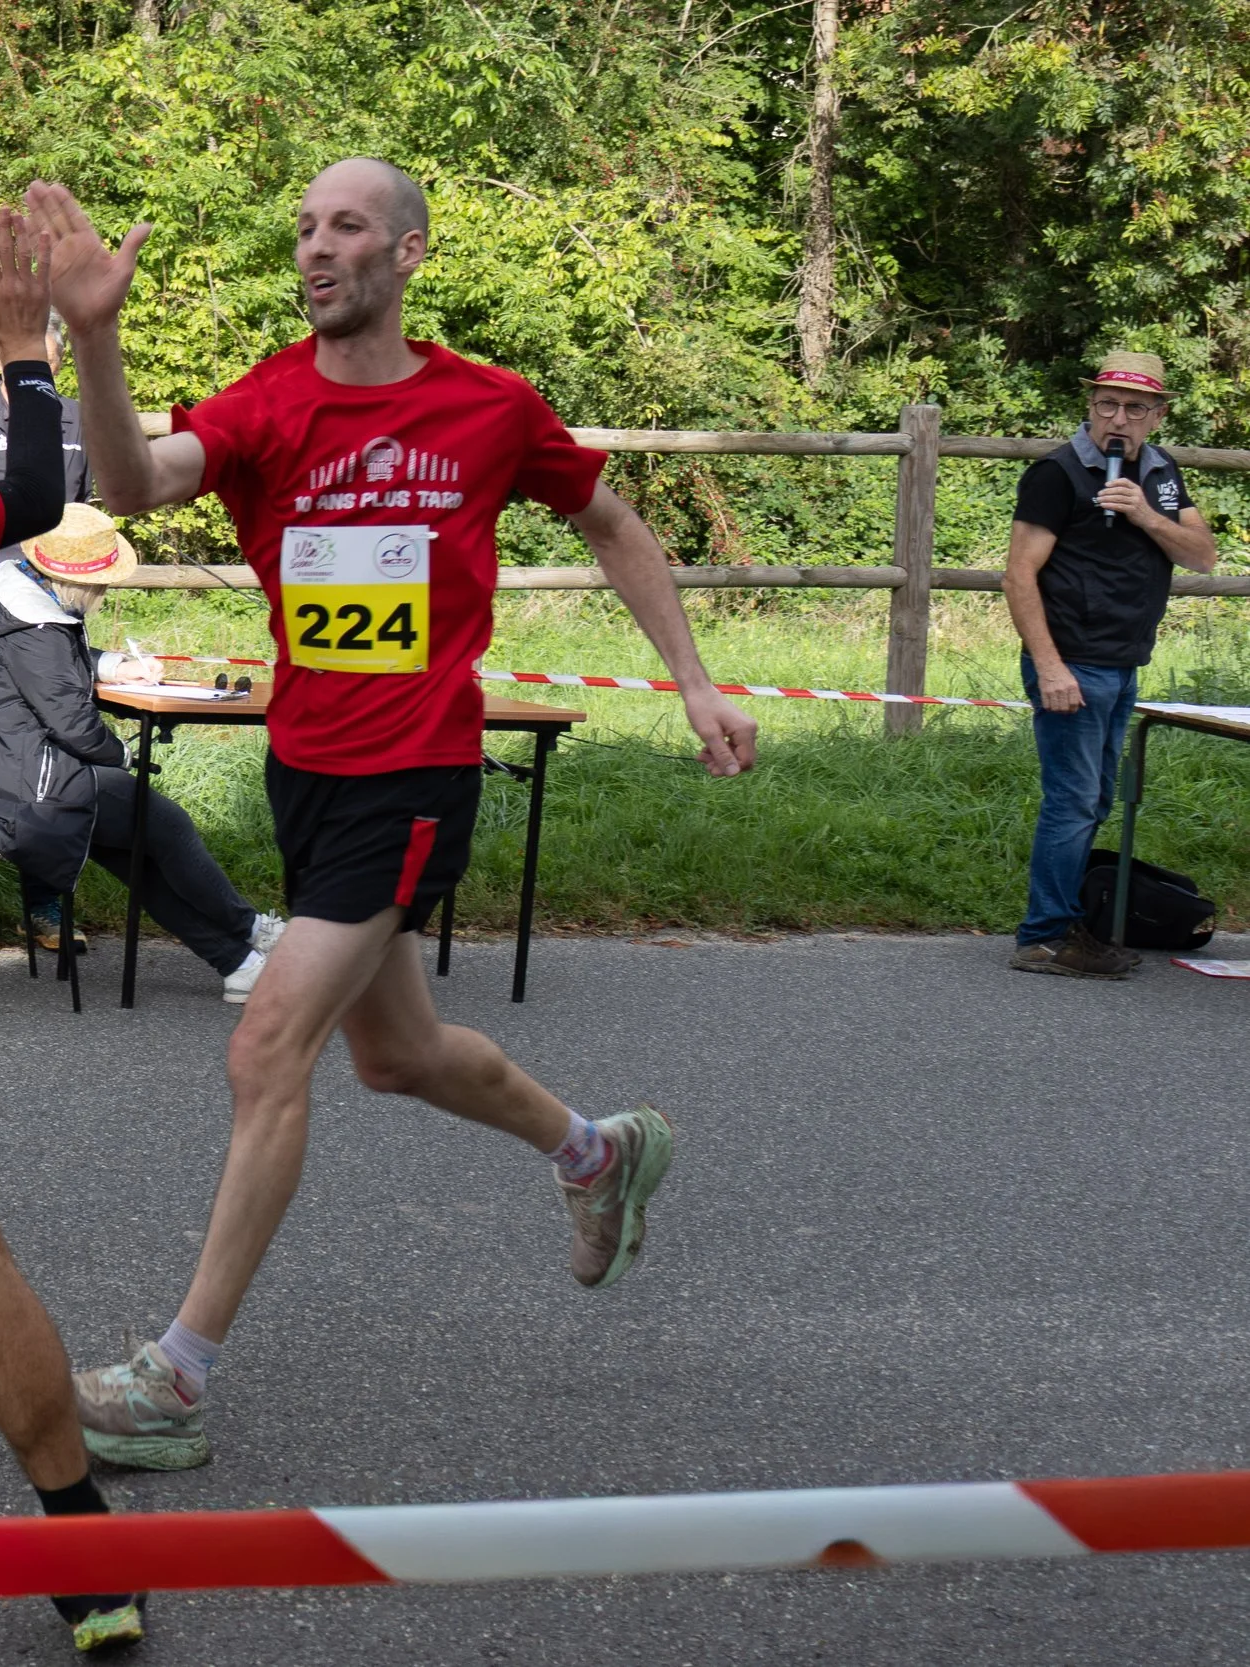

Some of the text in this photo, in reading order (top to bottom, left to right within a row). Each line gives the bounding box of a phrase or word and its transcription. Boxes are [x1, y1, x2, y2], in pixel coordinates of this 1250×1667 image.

[294, 496, 312, 512] 10
[316, 493, 357, 510] ANS
[359, 490, 411, 508] PLUS
[295, 602, 418, 650] 224
